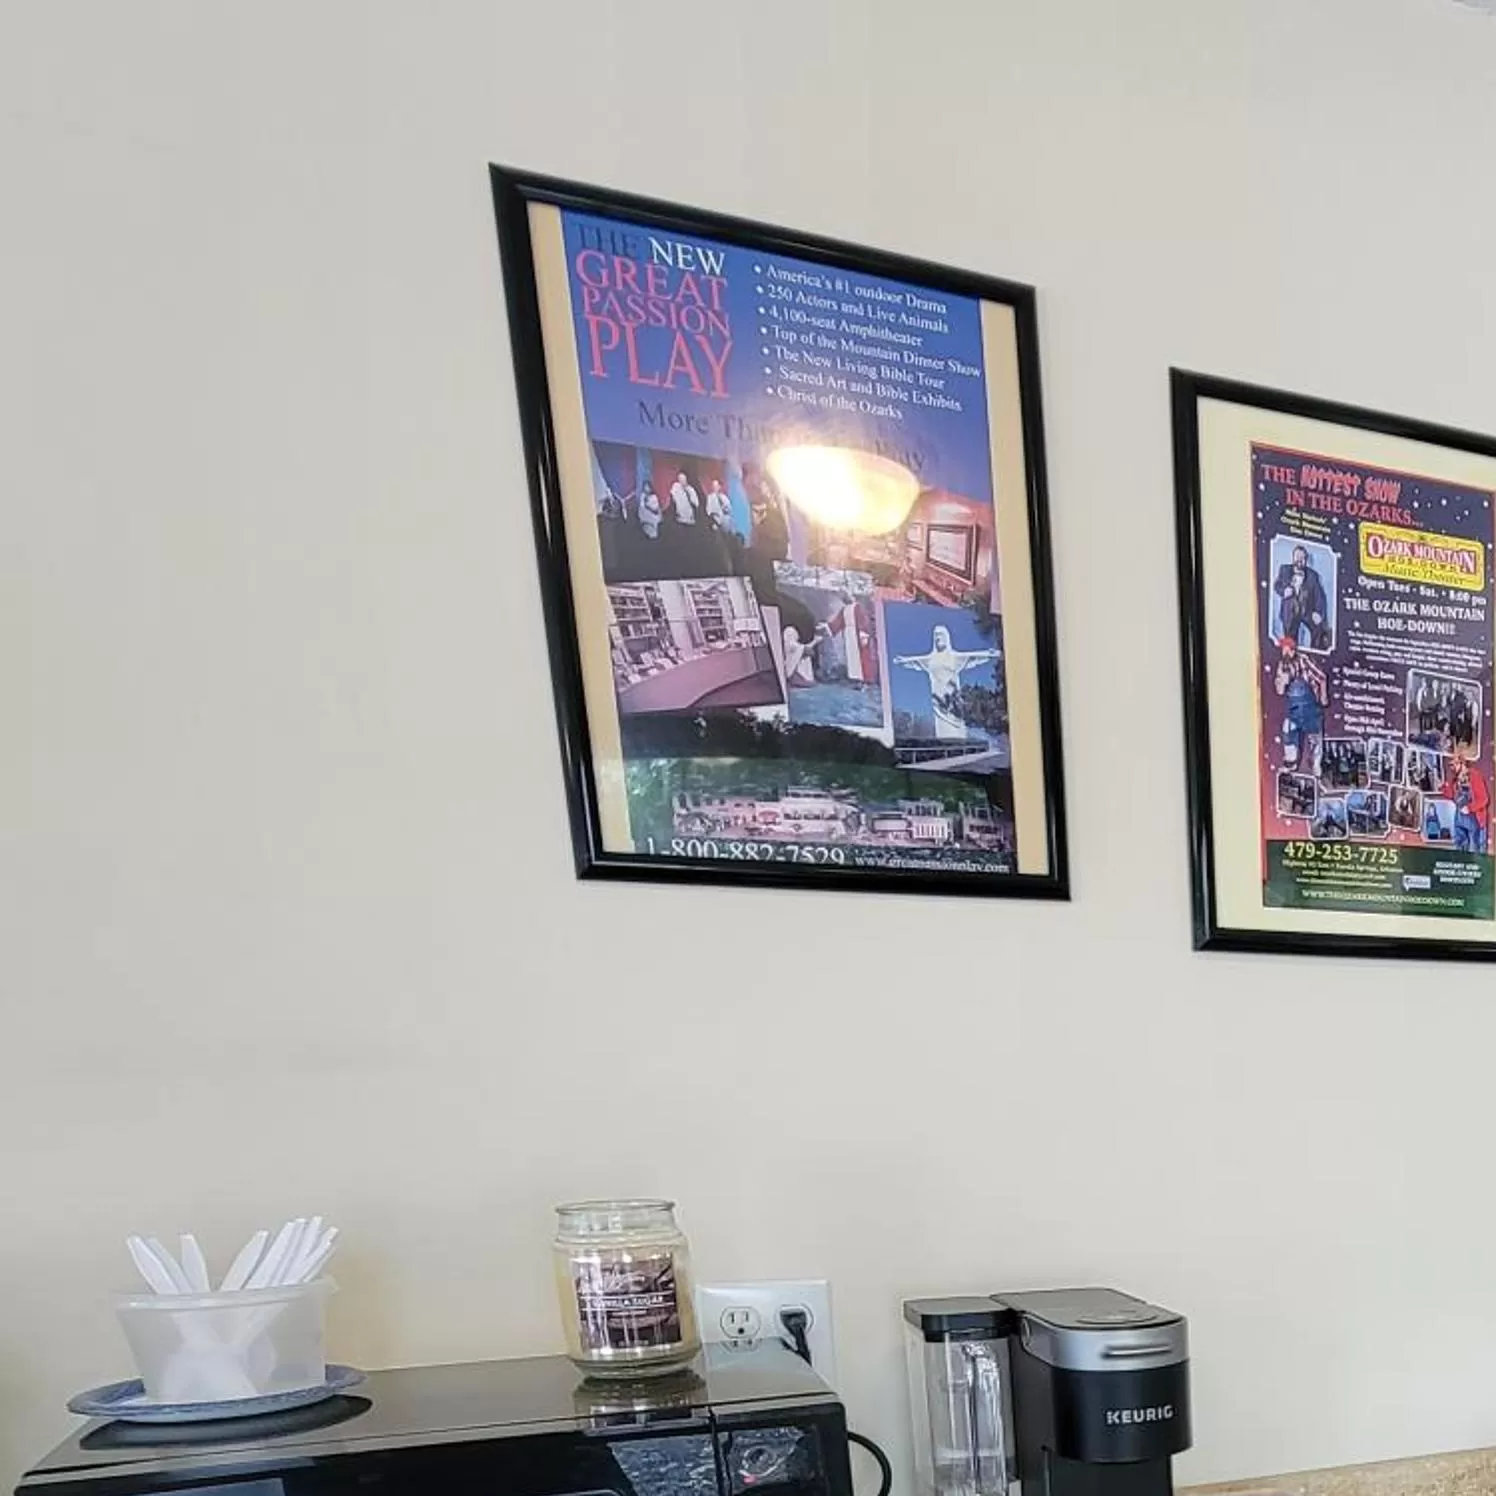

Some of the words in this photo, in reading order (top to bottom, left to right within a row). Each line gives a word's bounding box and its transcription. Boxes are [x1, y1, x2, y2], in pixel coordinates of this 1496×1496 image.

[648, 237, 725, 276] NEW
[576, 249, 728, 311] GREAT
[767, 265, 832, 290] America's
[905, 292, 947, 314] Drama
[583, 285, 733, 339] PASSION
[767, 284, 793, 301] 250
[795, 290, 838, 311] Actors
[841, 302, 864, 317] and
[867, 303, 896, 322] Live
[898, 311, 949, 334] Animals
[772, 324, 797, 344] Top
[800, 332, 816, 345] of
[817, 333, 837, 350] the
[840, 339, 901, 362] Mountain
[903, 350, 946, 371] Dinner
[947, 358, 981, 378] Show
[839, 319, 924, 347] Amphitheater
[586, 313, 733, 399] PLAY
[775, 343, 799, 363] The
[802, 350, 832, 368] New
[836, 356, 879, 380] Living
[880, 364, 914, 384] Bible
[916, 372, 945, 390] Tour
[777, 384, 817, 406] Christ
[819, 394, 835, 408] of
[836, 397, 857, 413] the
[859, 400, 904, 421] Ozarks
[779, 364, 823, 387] Sacred
[826, 375, 848, 391] Art
[850, 381, 873, 396] and
[876, 382, 909, 402] Bible
[912, 390, 963, 413] Exhibits
[637, 400, 711, 435] More
[1260, 464, 1297, 487] THE
[1300, 464, 1361, 497] HOTTEST
[1364, 476, 1401, 505] SHOW
[1285, 488, 1307, 508] IN
[1308, 491, 1343, 514] THE
[1367, 535, 1412, 558] OZARK
[1413, 544, 1476, 574] MOUNTAIN
[1343, 597, 1370, 612] THE
[1372, 600, 1418, 616] OZARK
[1420, 604, 1486, 622] MOUNTAIN
[1357, 575, 1385, 590] Open
[1471, 595, 1487, 607] pm
[1284, 841, 1399, 865] 479-253-7725
[1106, 1404, 1174, 1425] KEURIG
